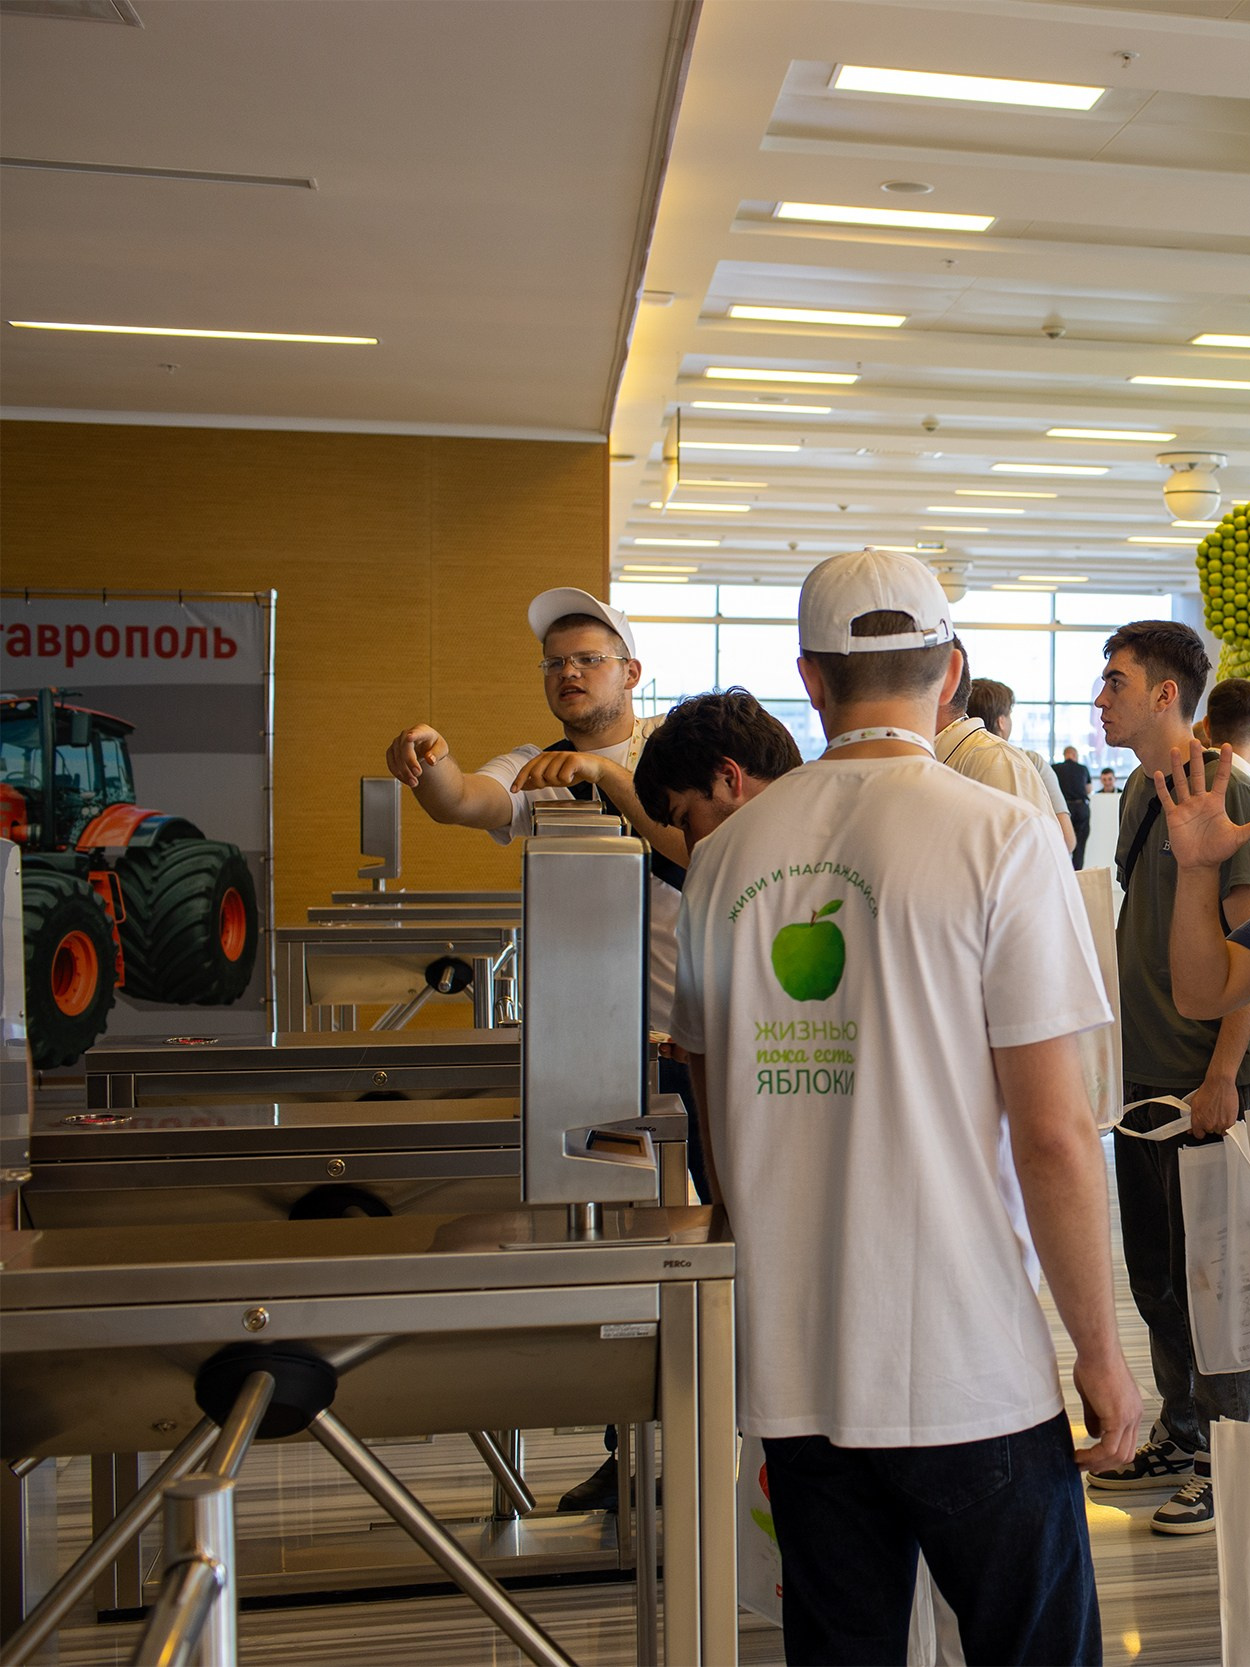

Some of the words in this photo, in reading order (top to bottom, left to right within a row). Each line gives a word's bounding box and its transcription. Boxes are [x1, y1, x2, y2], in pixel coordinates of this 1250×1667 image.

[728, 877, 768, 923] ЖИВИ
[771, 869, 784, 882] И
[789, 861, 879, 919] НАСЛАЖДАЙСЯ
[754, 1020, 858, 1041] ЖИЗНЬЮ
[756, 1048, 810, 1064] пока
[813, 1048, 856, 1064] есть
[756, 1068, 855, 1097] ЯБЛОКИ
[663, 1260, 692, 1269] PERCo
